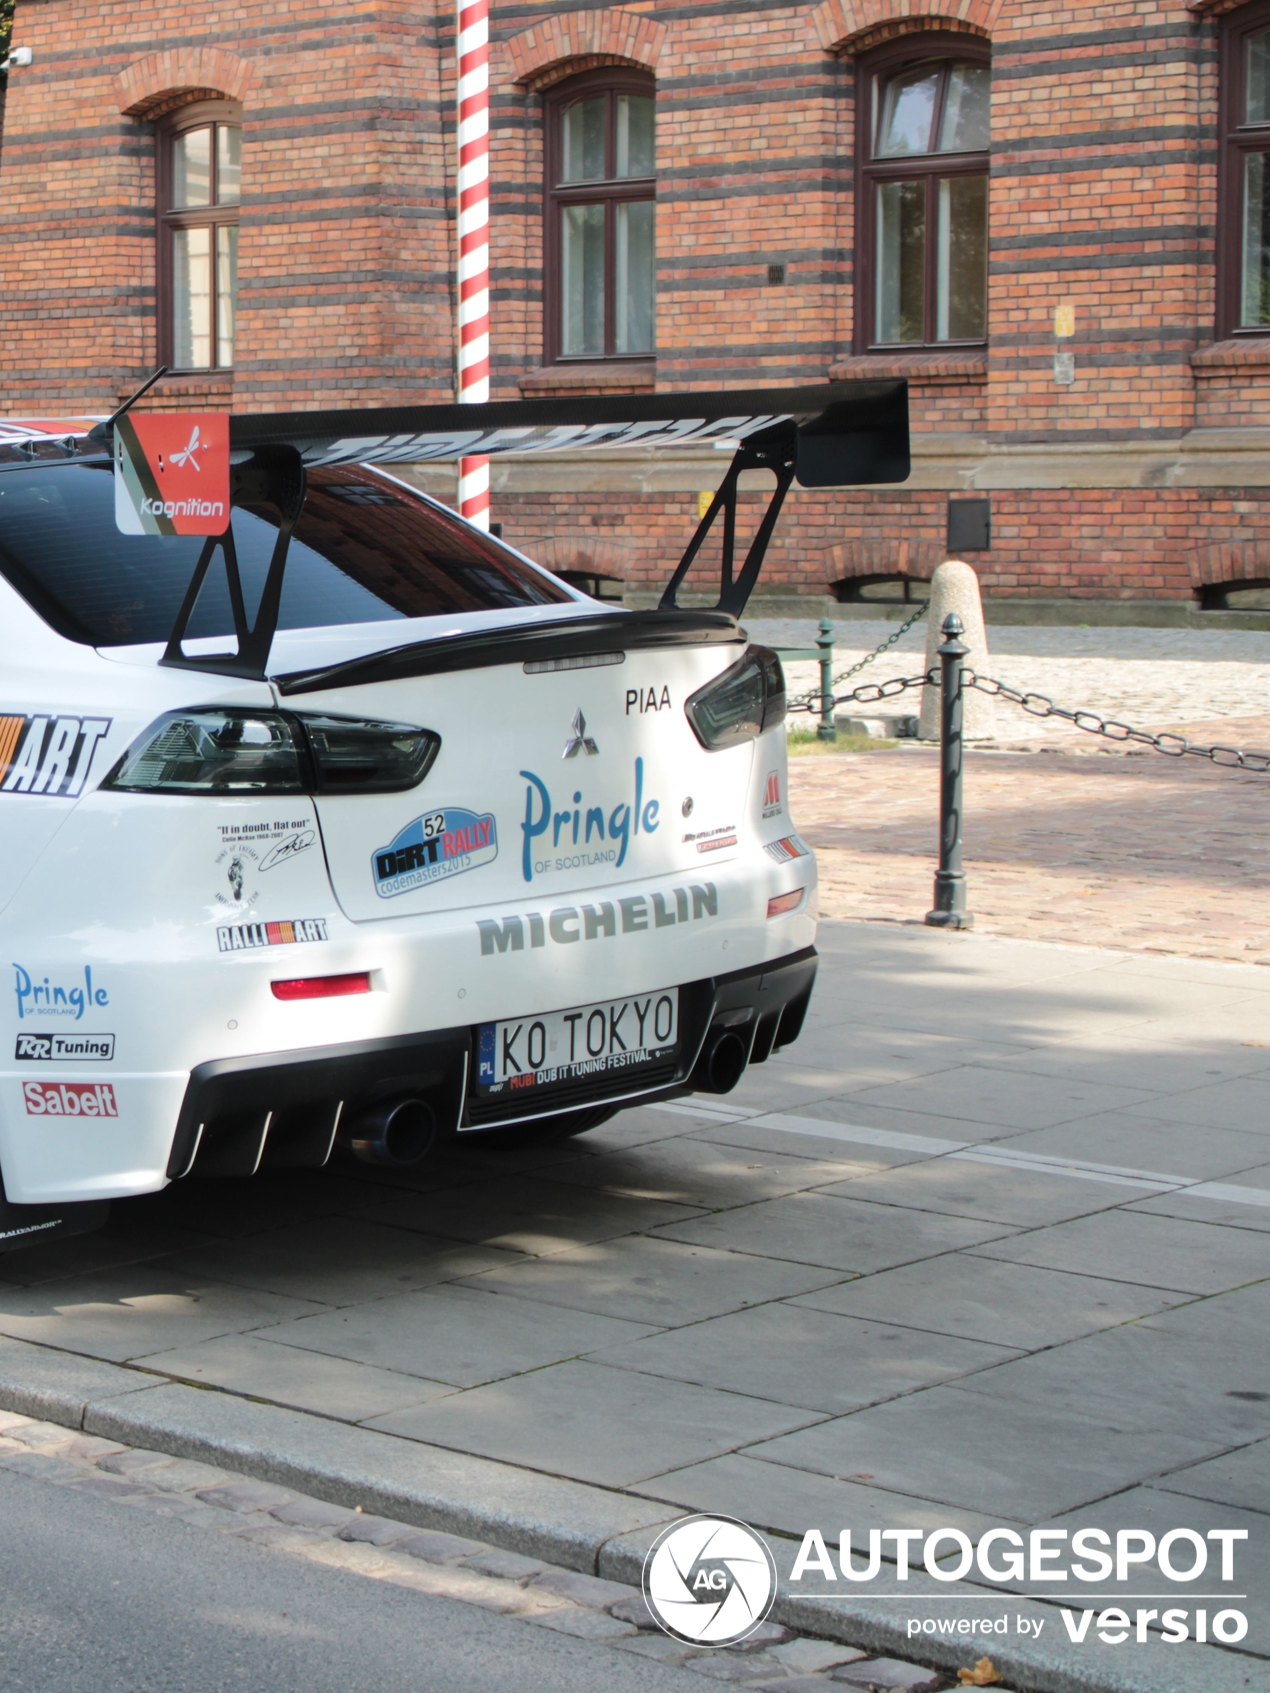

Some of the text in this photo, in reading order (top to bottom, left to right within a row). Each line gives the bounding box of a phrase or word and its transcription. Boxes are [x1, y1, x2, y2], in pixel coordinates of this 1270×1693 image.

[140, 498, 224, 518] Kognition
[626, 685, 672, 716] PIAA
[231, 824, 241, 834] in
[242, 822, 272, 833] doubt,
[274, 821, 290, 831] flat
[424, 814, 446, 838] 52
[519, 756, 660, 883] Pringle
[376, 818, 492, 880] DiRT RALLY
[534, 850, 617, 875] OF SCOTLAND
[476, 882, 719, 954] MICHELIN
[12, 963, 110, 1020] Pringle
[55, 1040, 110, 1057] Tuning
[503, 995, 673, 1076] KO TOKYO
[480, 1062, 493, 1076] PL
[510, 1073, 536, 1090] MUBI
[537, 1068, 557, 1084] DUB
[558, 1065, 569, 1079] IT
[570, 1057, 606, 1077] TUNING
[607, 1049, 652, 1069] FESTIVAL
[25, 1082, 117, 1116] Sabelt
